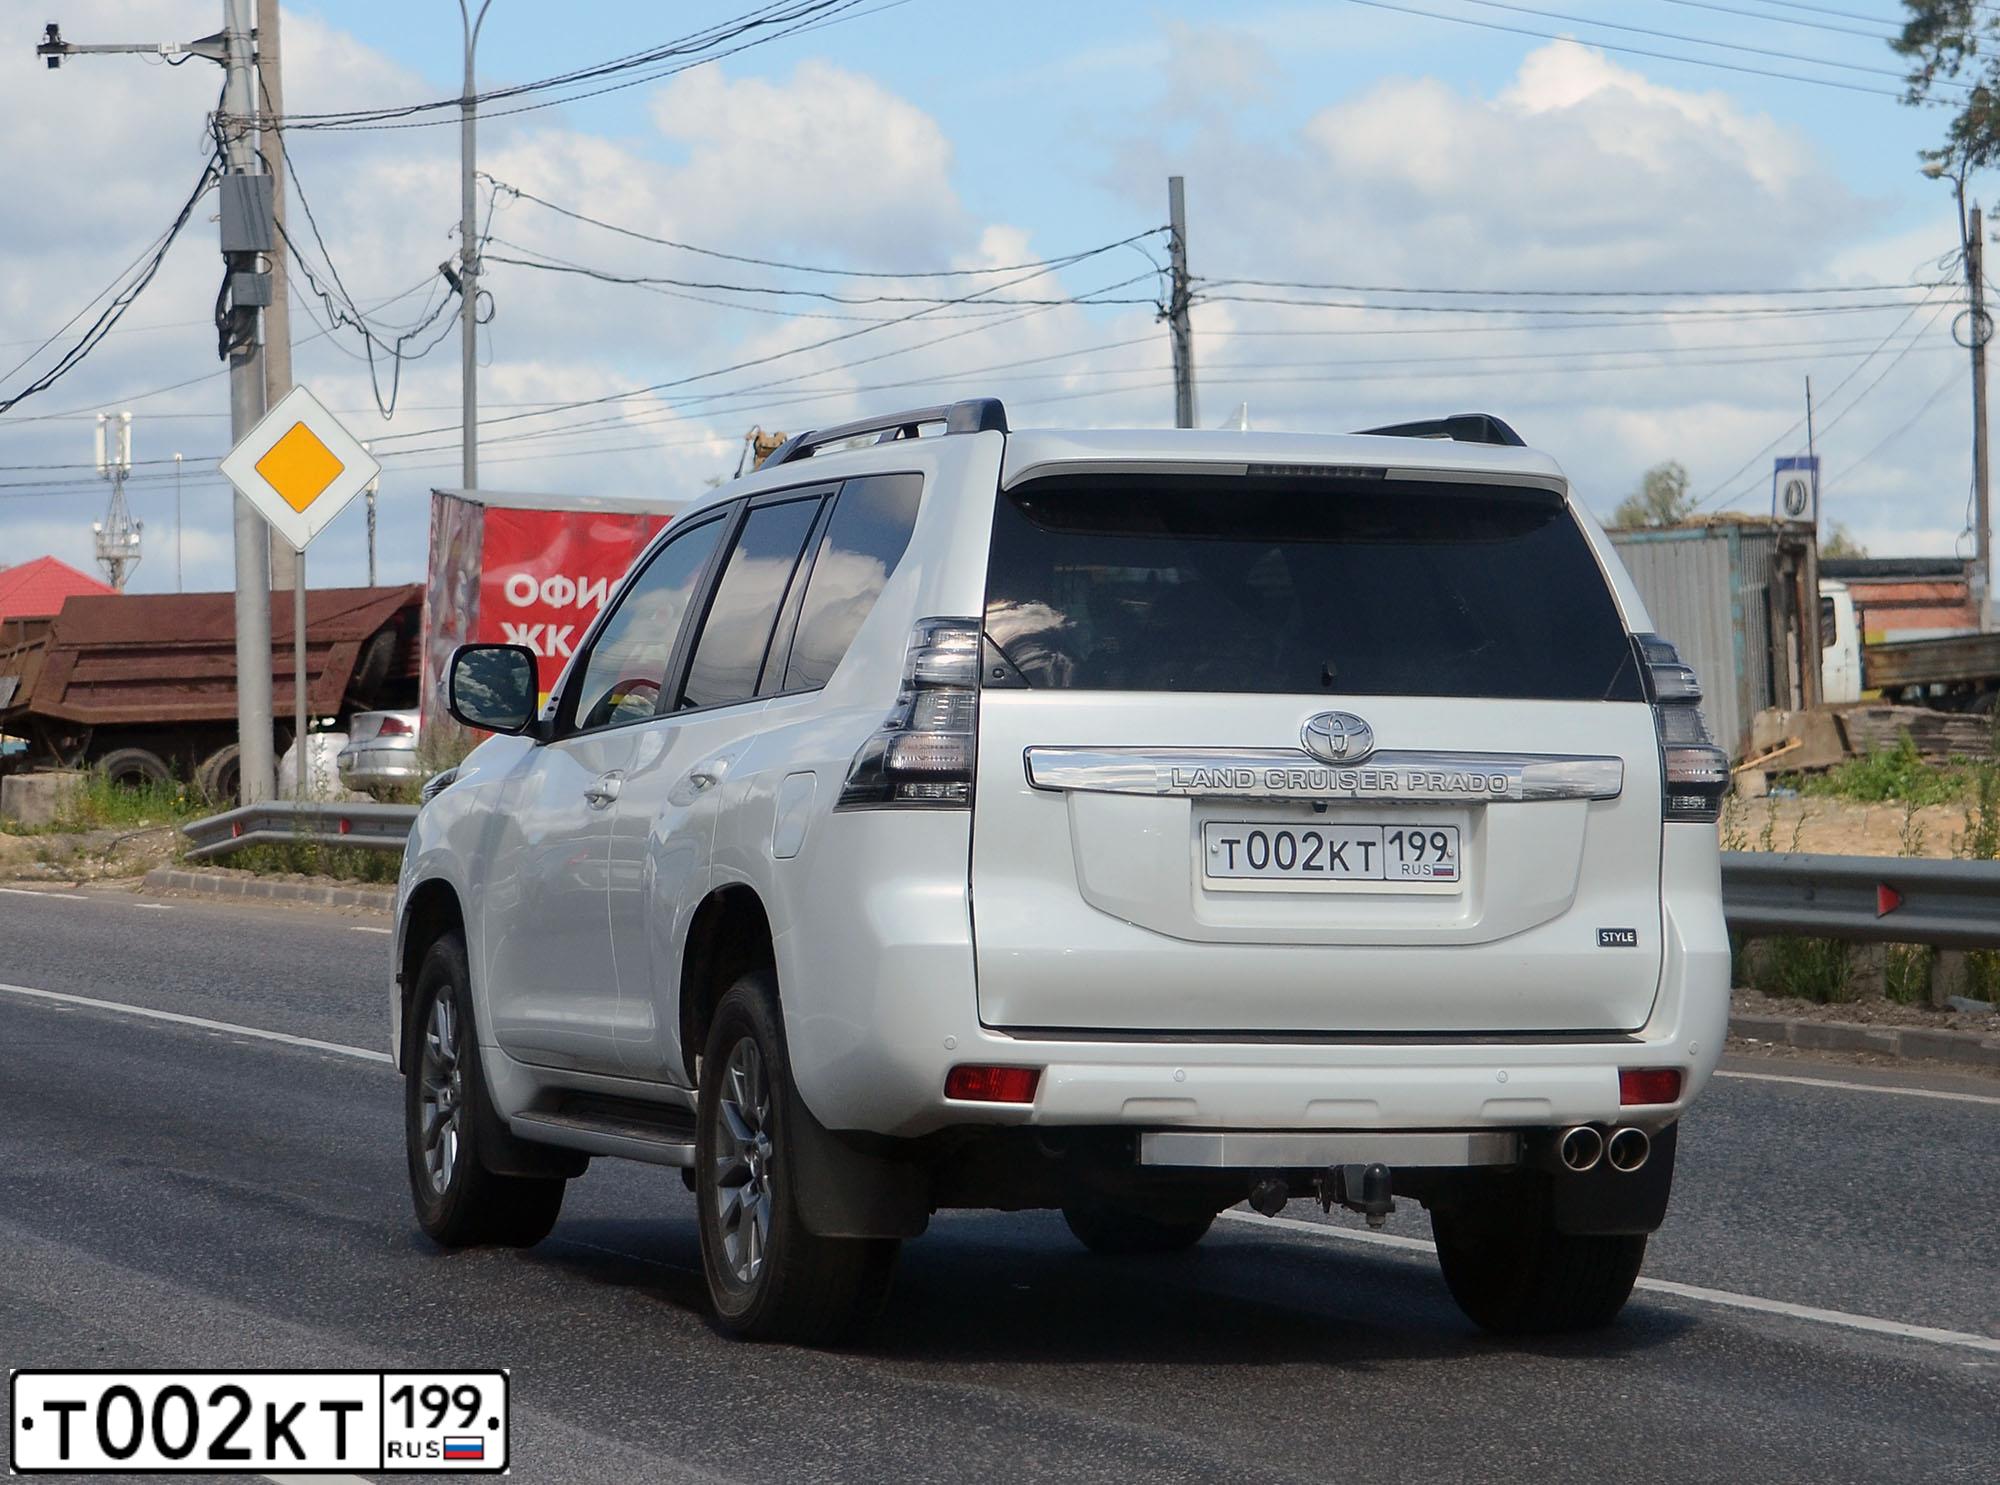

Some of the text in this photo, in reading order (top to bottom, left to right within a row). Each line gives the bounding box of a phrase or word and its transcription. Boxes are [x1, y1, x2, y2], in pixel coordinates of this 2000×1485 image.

[500, 622, 575, 658] ЖК
[1171, 767, 1508, 793] LAND CRUISER PRADO
[1388, 830, 1449, 862] 199
[1401, 863, 1432, 876] RUS
[1601, 931, 1635, 942] STYLE
